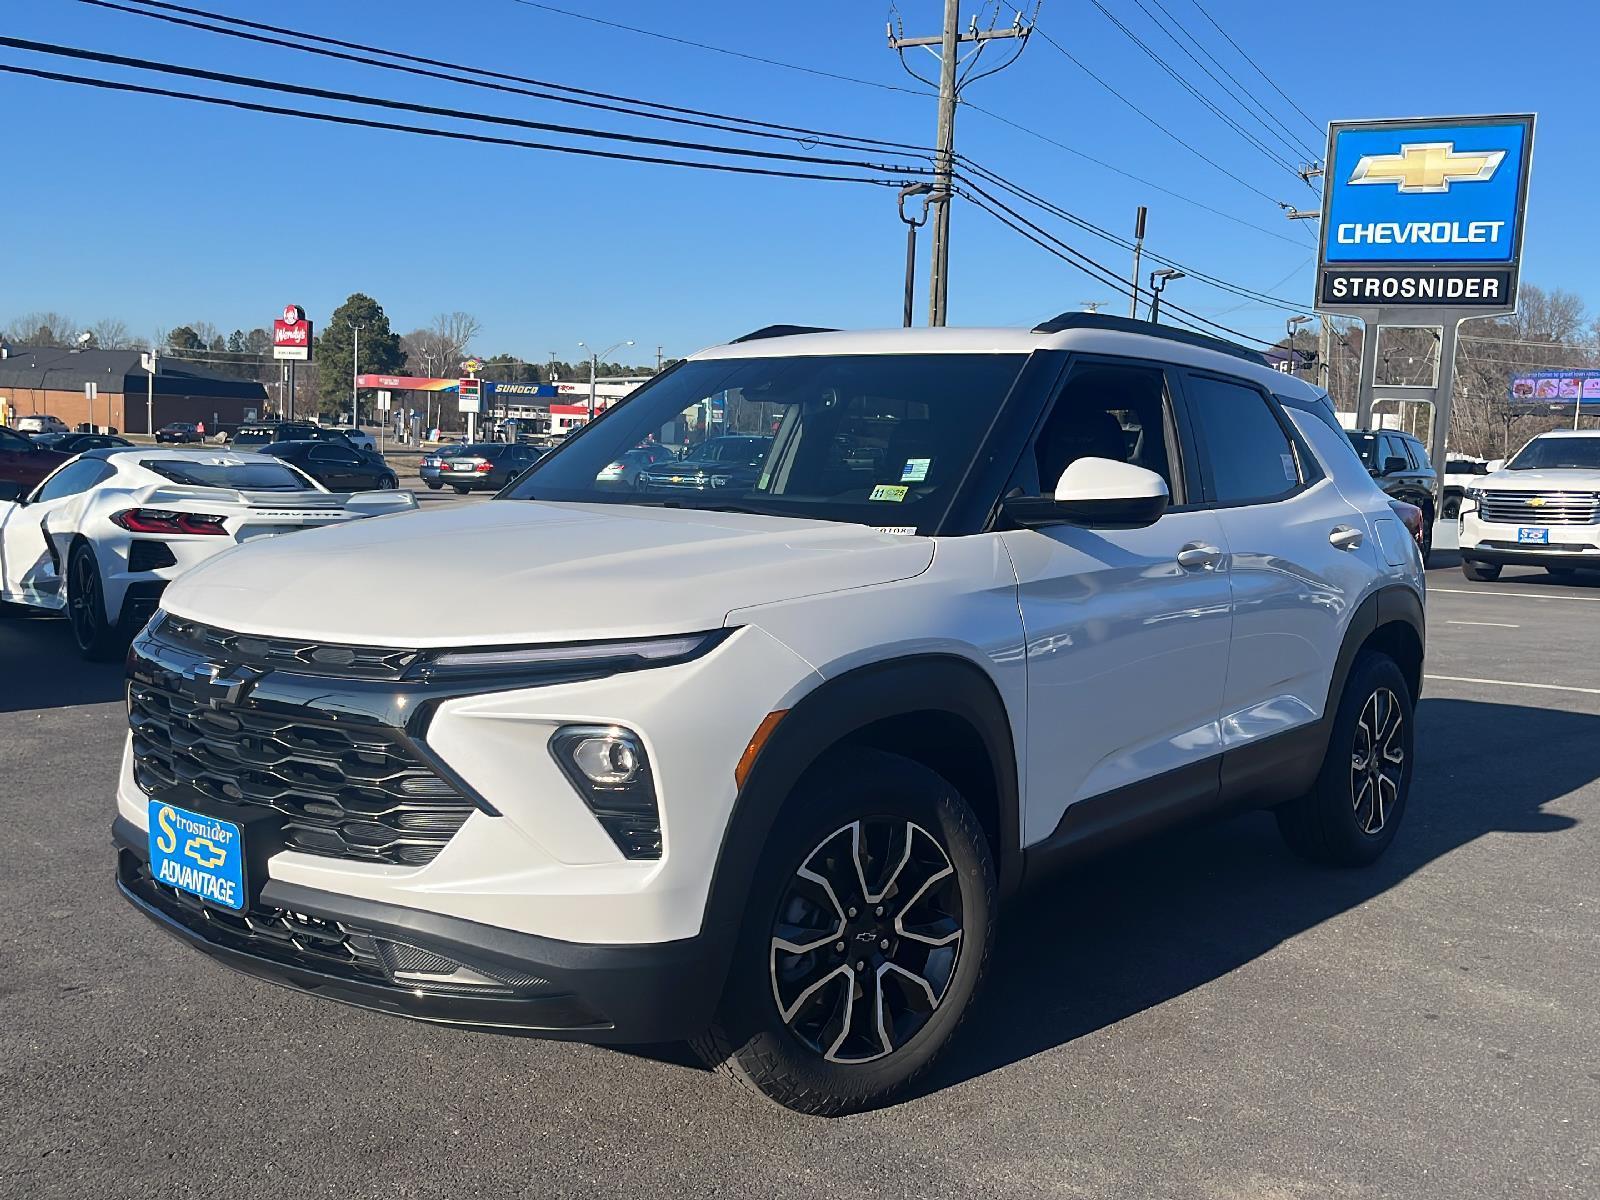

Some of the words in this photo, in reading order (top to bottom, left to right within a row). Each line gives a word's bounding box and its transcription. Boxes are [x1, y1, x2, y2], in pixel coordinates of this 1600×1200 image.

[1337, 221, 1505, 244] CHEVROLET
[1332, 278, 1499, 299] STROSNIDER
[276, 327, 306, 343] Wendy's
[495, 384, 539, 394] SUNOCO
[873, 489, 885, 498] 11
[156, 806, 233, 854] Strosnider
[159, 858, 236, 905] ADVANTAGE
